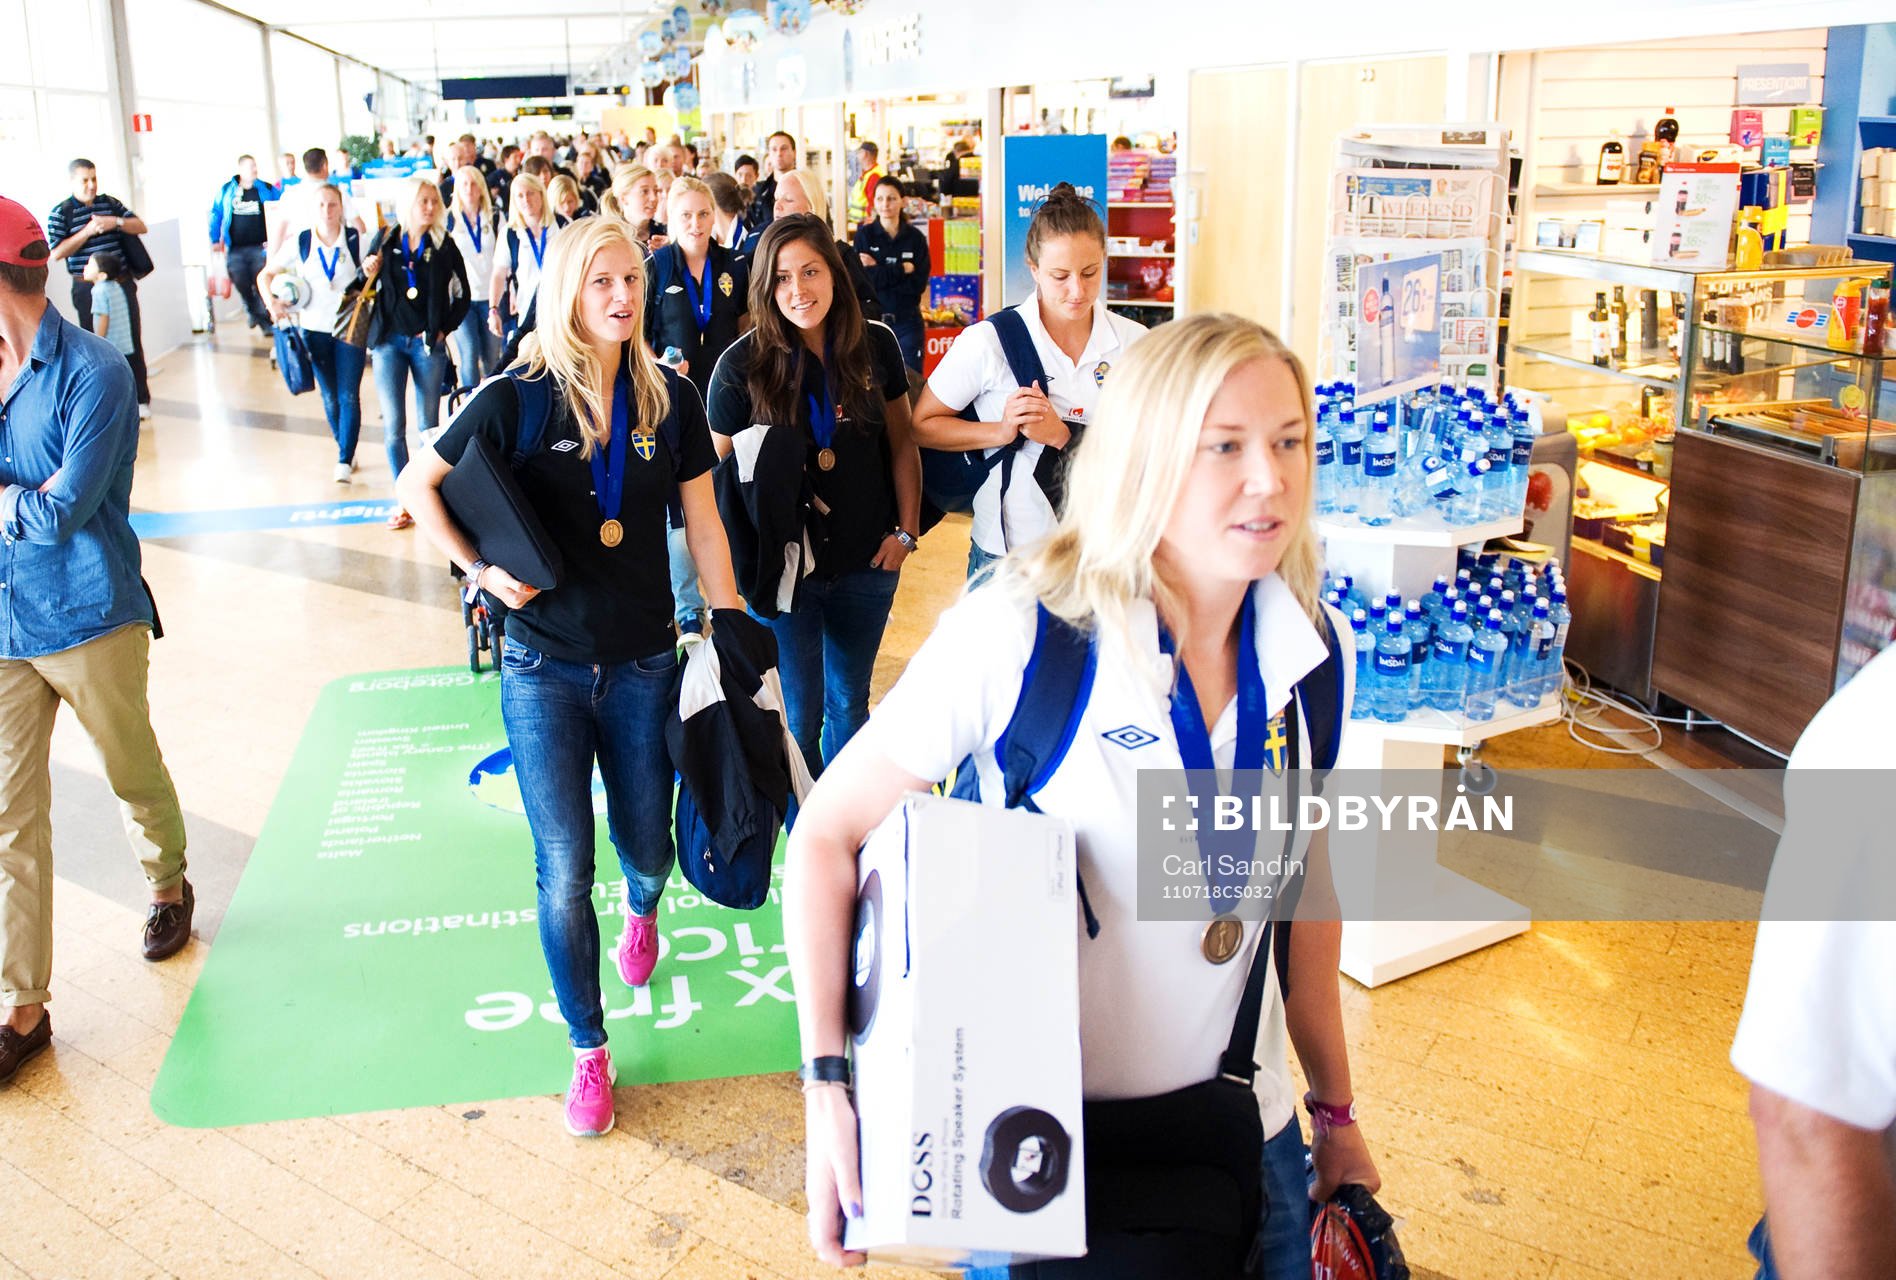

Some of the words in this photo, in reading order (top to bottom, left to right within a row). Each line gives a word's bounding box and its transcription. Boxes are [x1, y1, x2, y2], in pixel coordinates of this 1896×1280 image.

[1018, 184, 1094, 202] Welme
[927, 338, 955, 355] Off
[328, 812, 395, 826] Portugal
[324, 825, 379, 837] Poland
[320, 833, 422, 848] Netherlands
[316, 849, 363, 860] Malta
[343, 908, 538, 938] stinations
[464, 976, 702, 1031] fre
[953, 1027, 966, 1082] System
[952, 1087, 965, 1148] Speaker
[951, 1153, 965, 1219] Rotating
